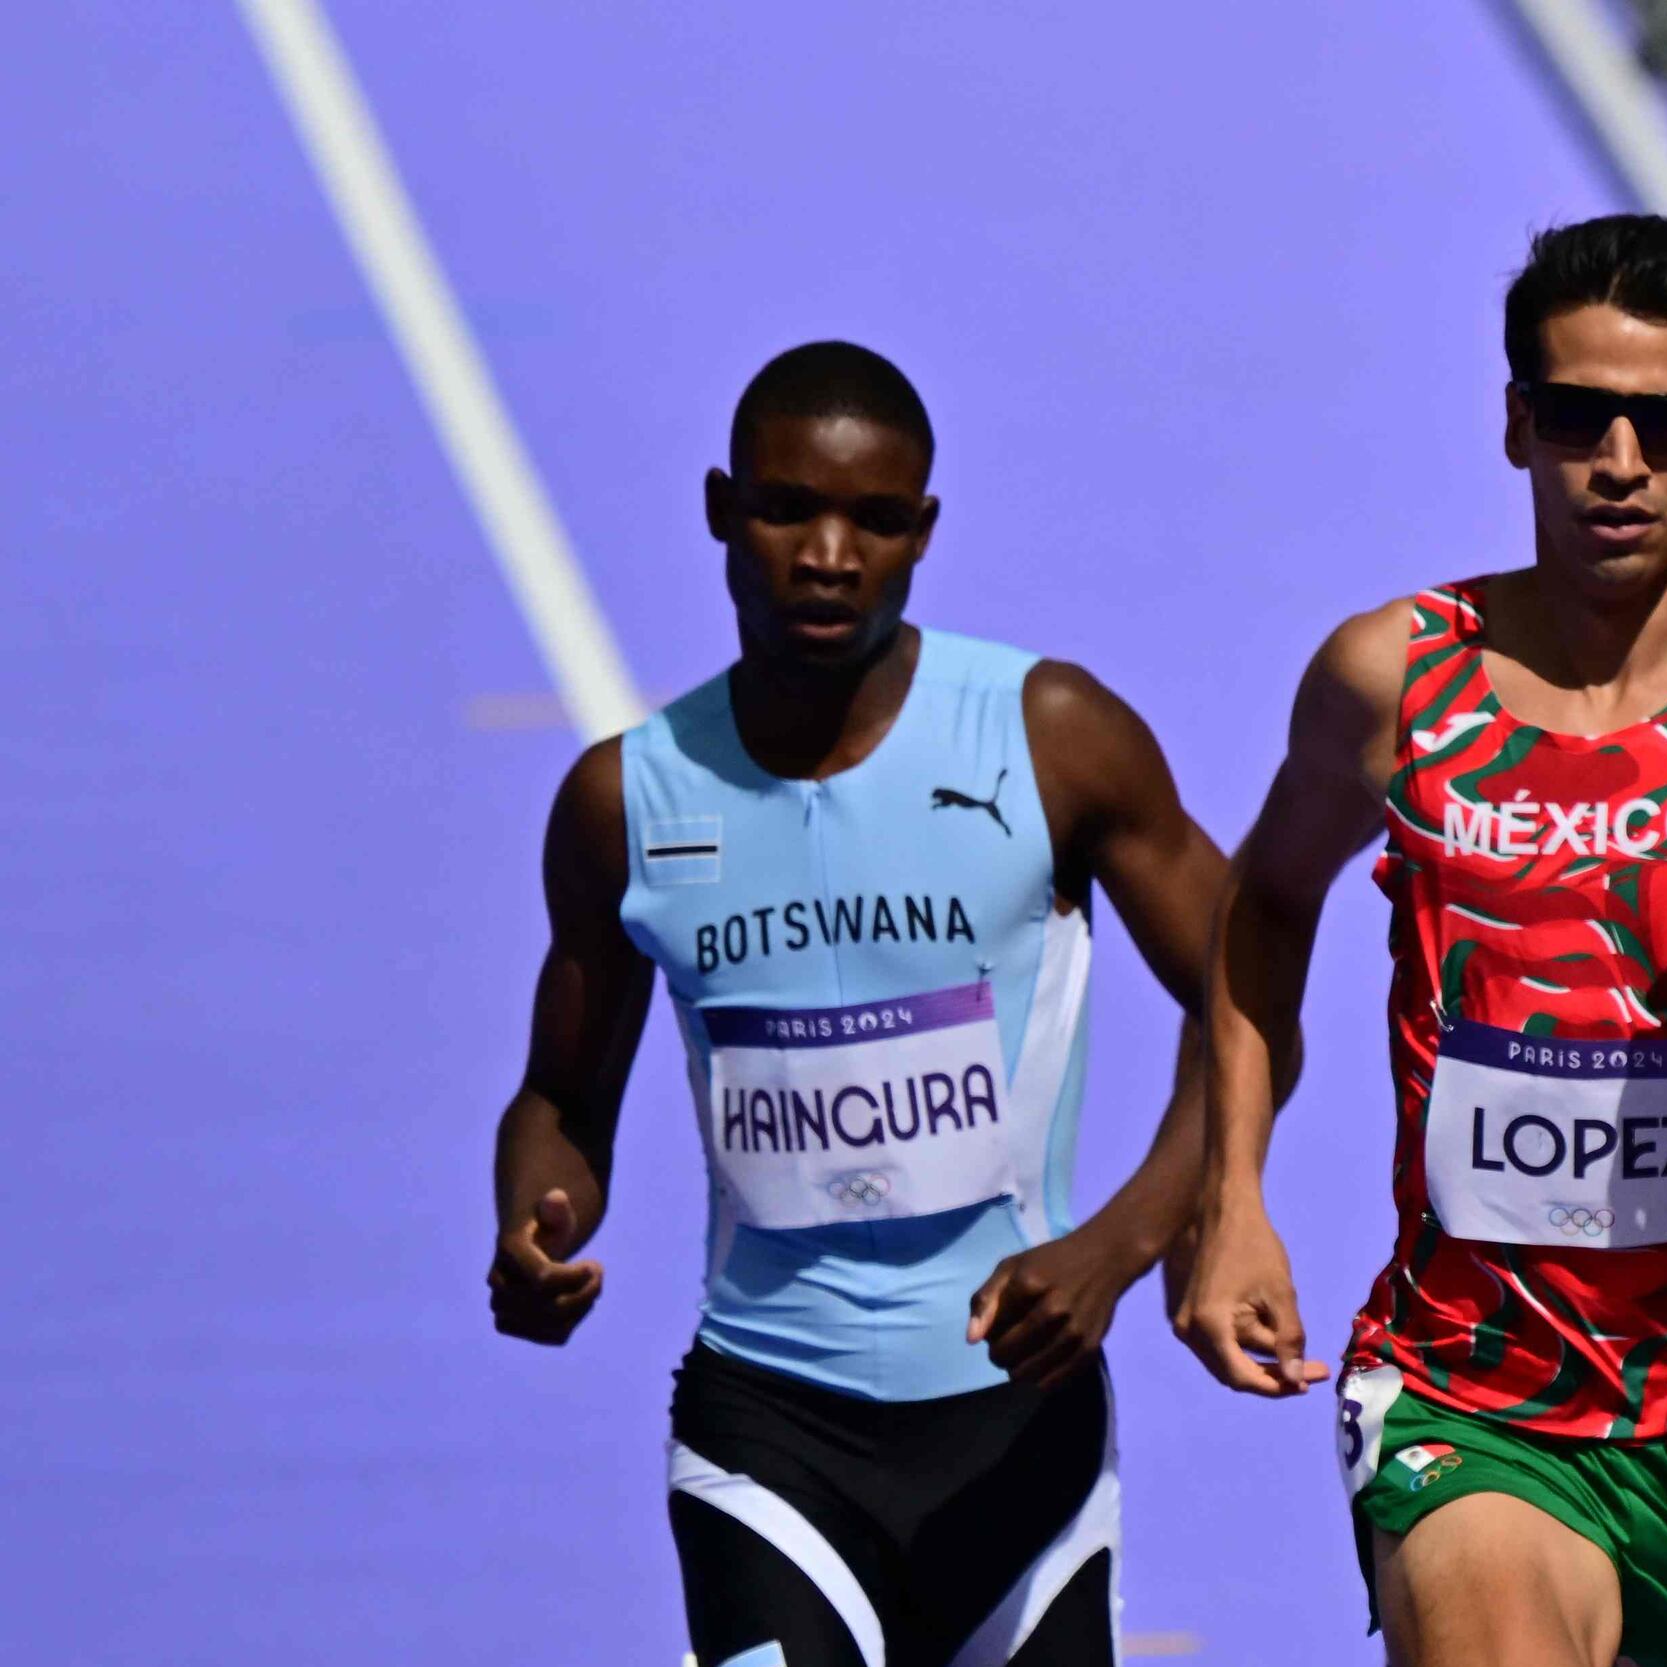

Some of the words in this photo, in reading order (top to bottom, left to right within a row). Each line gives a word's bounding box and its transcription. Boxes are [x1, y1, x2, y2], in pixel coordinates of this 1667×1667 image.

[695, 894, 977, 974] BOTSWANA
[766, 1017, 833, 1039] PARIS
[841, 1006, 914, 1036] 2024
[1508, 1041, 1582, 1069] PARIS
[1591, 1049, 1664, 1070] 2024
[722, 1062, 999, 1155] HAINGURA
